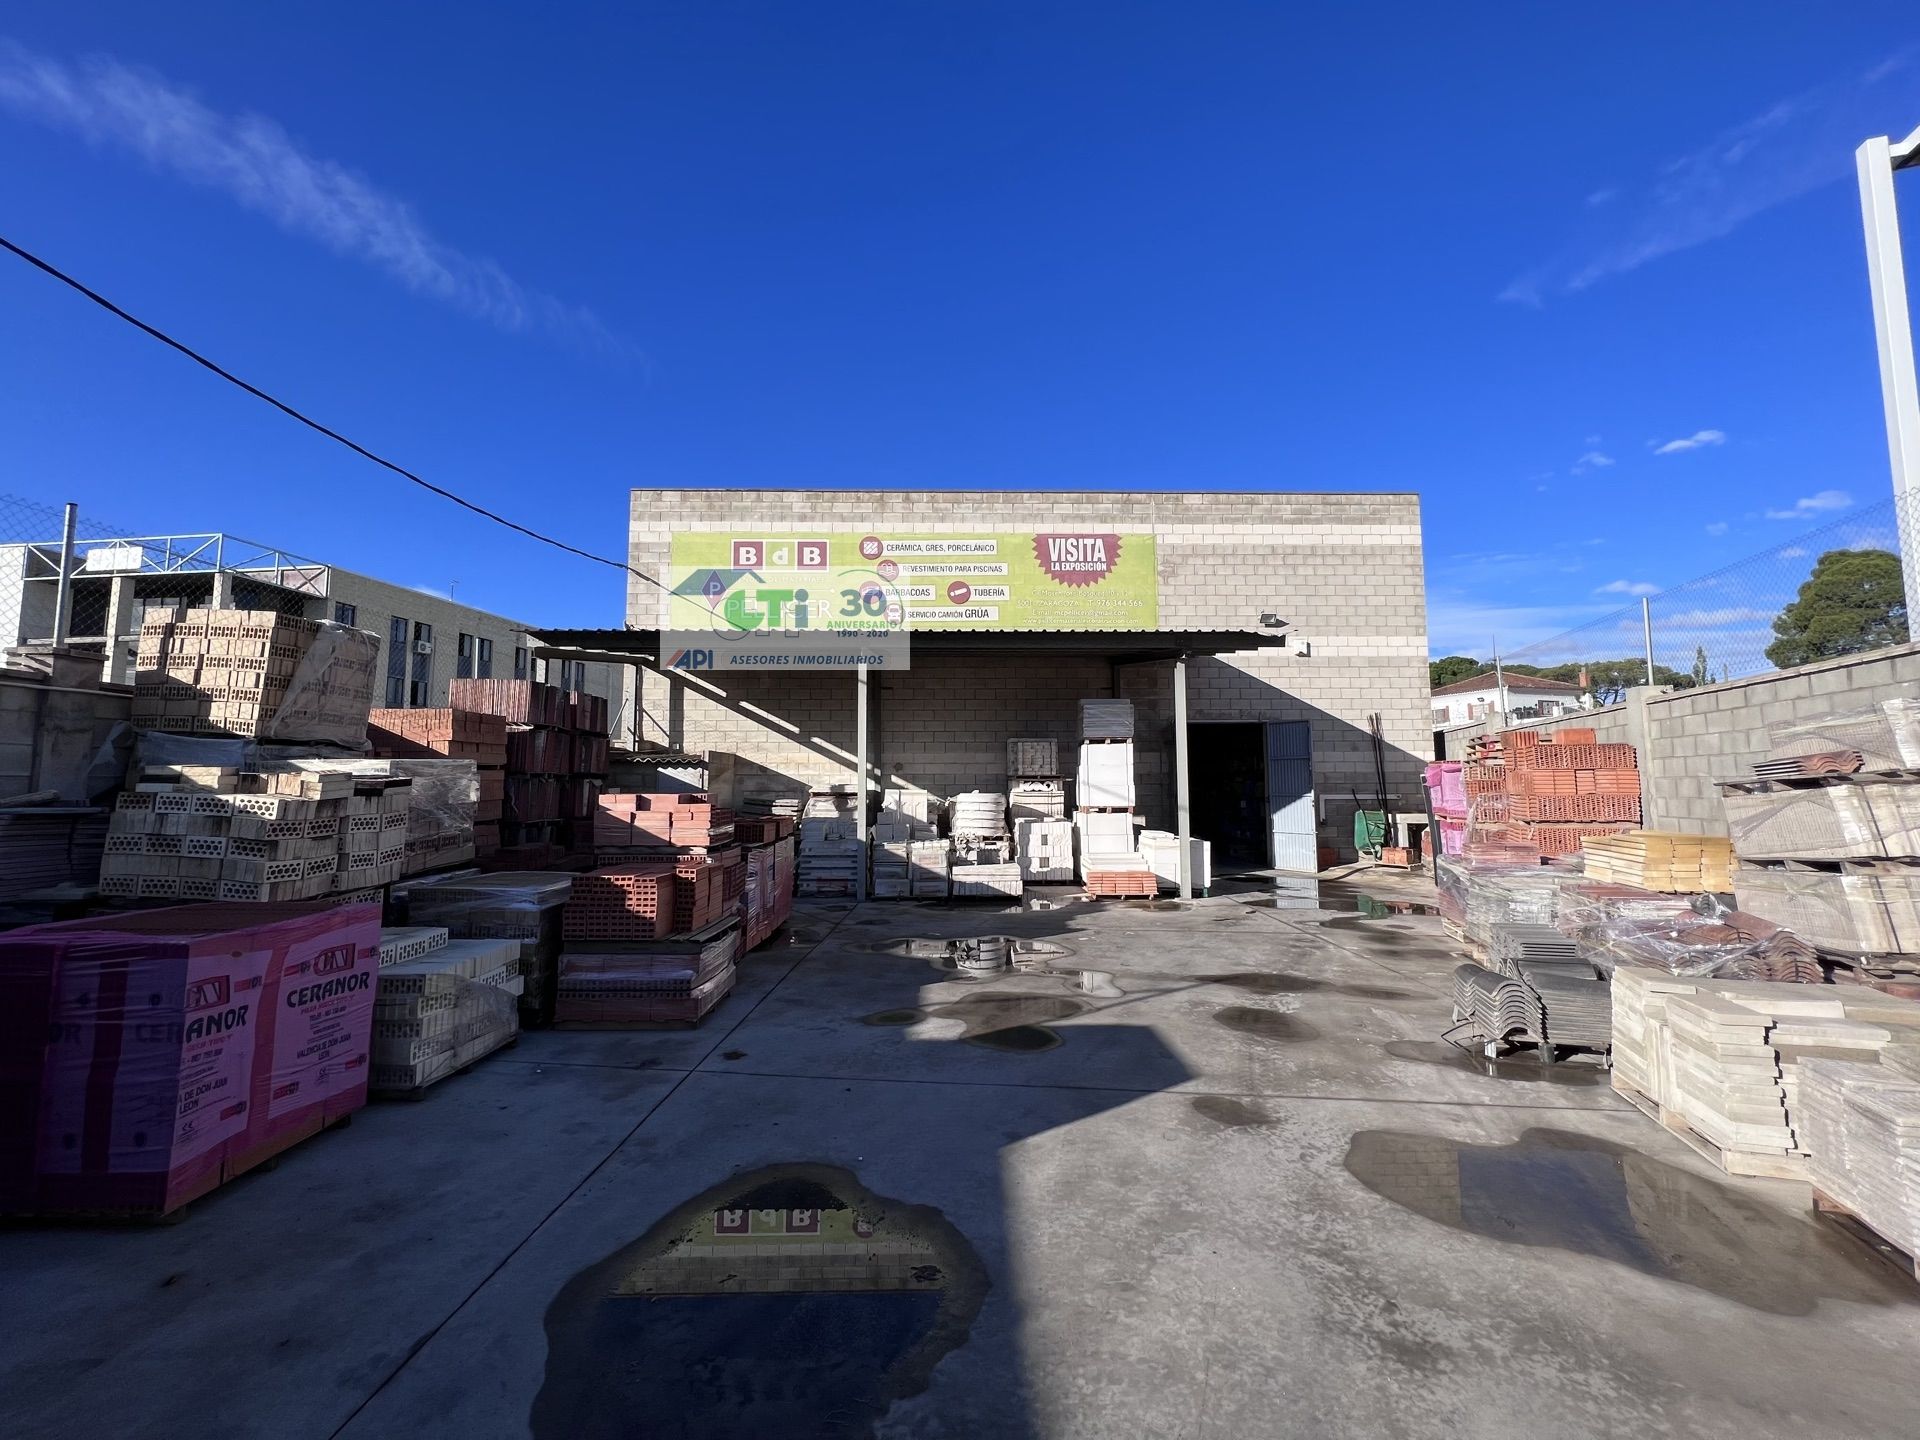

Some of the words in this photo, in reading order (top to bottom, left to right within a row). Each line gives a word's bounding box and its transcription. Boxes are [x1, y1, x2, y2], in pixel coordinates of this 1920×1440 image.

[886, 544, 924, 553] CERÁMICA,
[925, 545, 946, 553] GRES,
[947, 544, 995, 552] PORCELÁNICO
[1047, 537, 1107, 562] VISITA
[902, 565, 953, 573] REVESTIMIENTO
[954, 565, 973, 573] PARA
[973, 565, 1003, 573] PISCINAS
[1051, 562, 1061, 571] LA
[1061, 560, 1107, 572] EXPOSICIÓN
[885, 588, 931, 596] BARBACOAS
[974, 587, 1005, 596] TUBERÍA
[1096, 599, 1110, 607] 976
[908, 611, 937, 619] SERVICIO
[938, 610, 964, 619] CAMIÓN
[964, 607, 990, 618] GRÚA
[286, 971, 370, 1008] CERANOR
